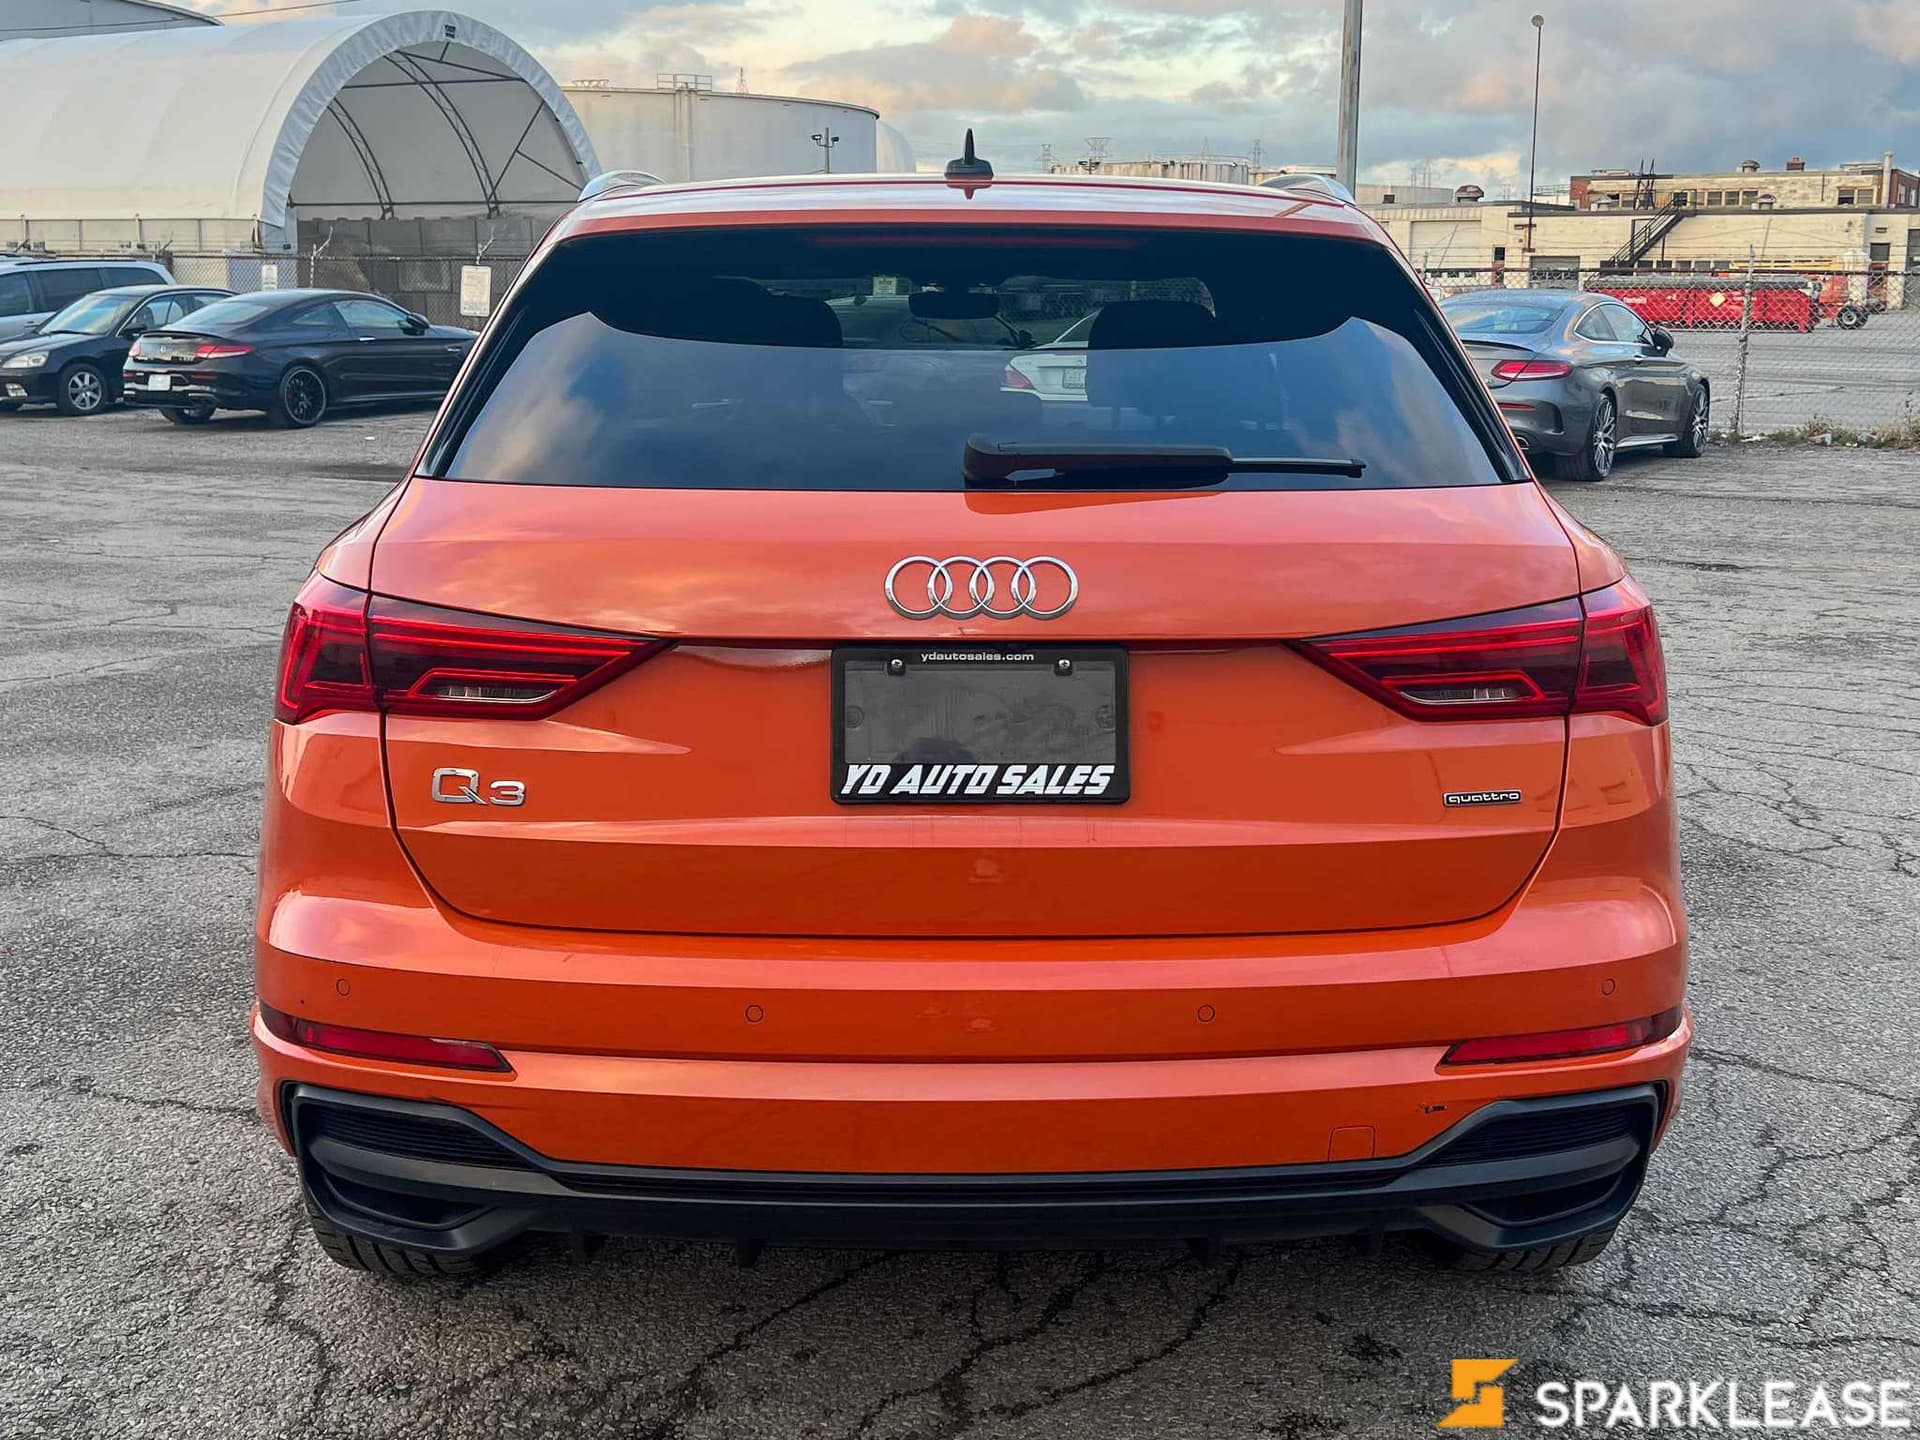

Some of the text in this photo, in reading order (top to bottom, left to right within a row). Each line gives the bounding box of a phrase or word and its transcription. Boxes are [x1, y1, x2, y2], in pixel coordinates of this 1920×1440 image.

[920, 651, 1035, 662] ydautosales.com
[432, 767, 525, 806] Q3
[840, 764, 1115, 795] YD AUTO SALES
[1448, 792, 1520, 804] quattro
